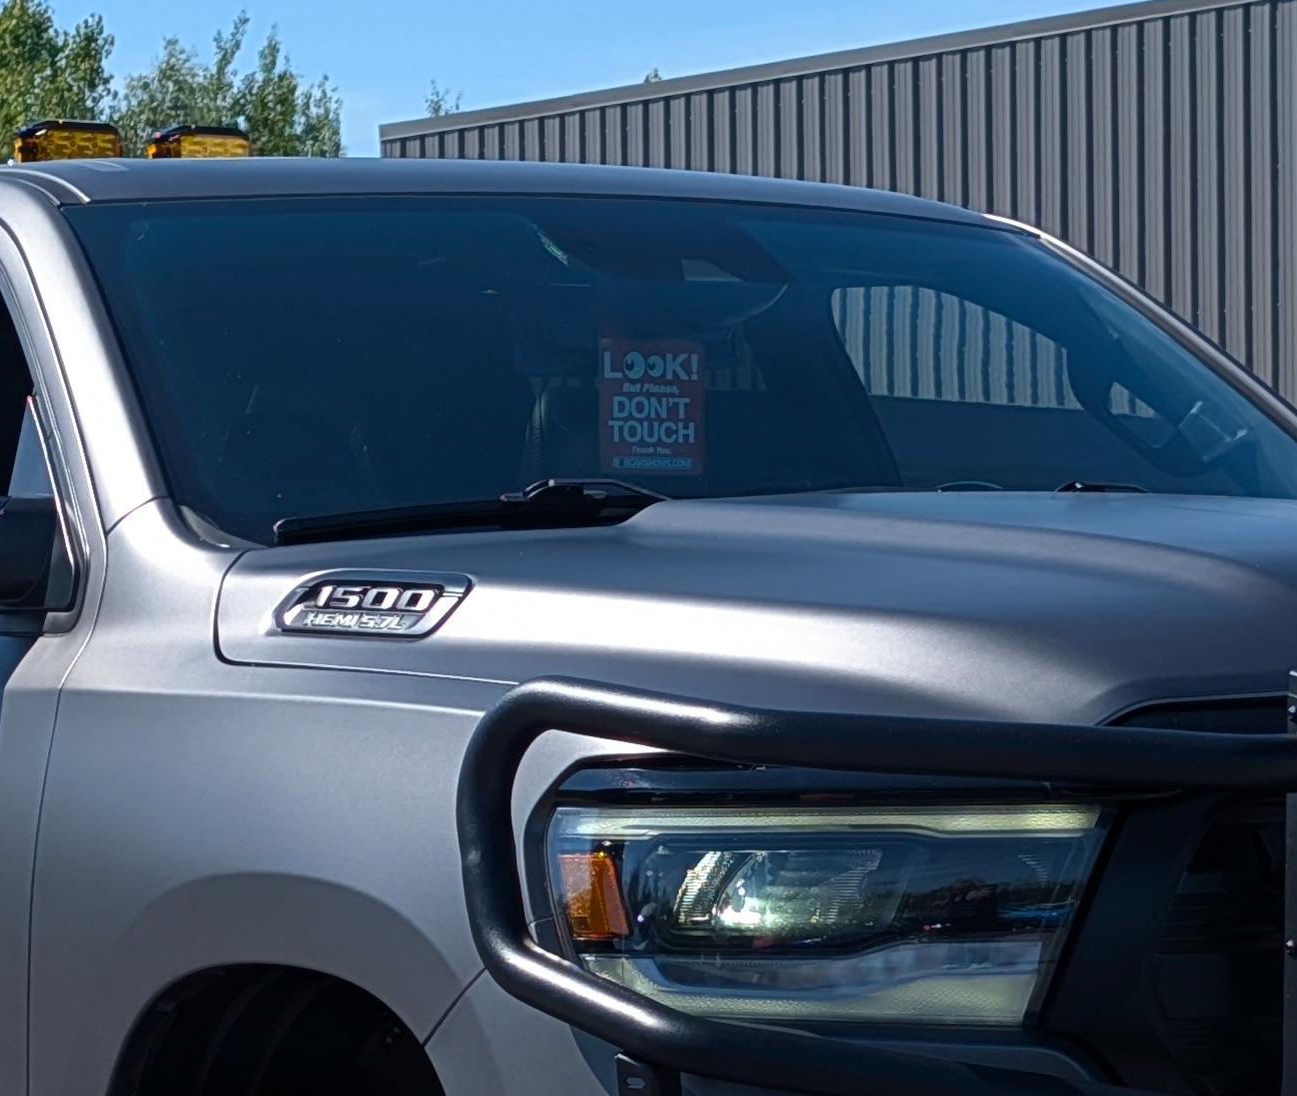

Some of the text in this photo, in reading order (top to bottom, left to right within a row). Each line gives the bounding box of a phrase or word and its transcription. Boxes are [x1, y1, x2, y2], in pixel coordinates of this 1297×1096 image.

[603, 351, 699, 380] LOOK!
[612, 396, 691, 419] DON'T
[608, 420, 695, 443] TOUCH
[316, 585, 439, 612] 1500
[303, 611, 406, 630] HEMI 5.7L
